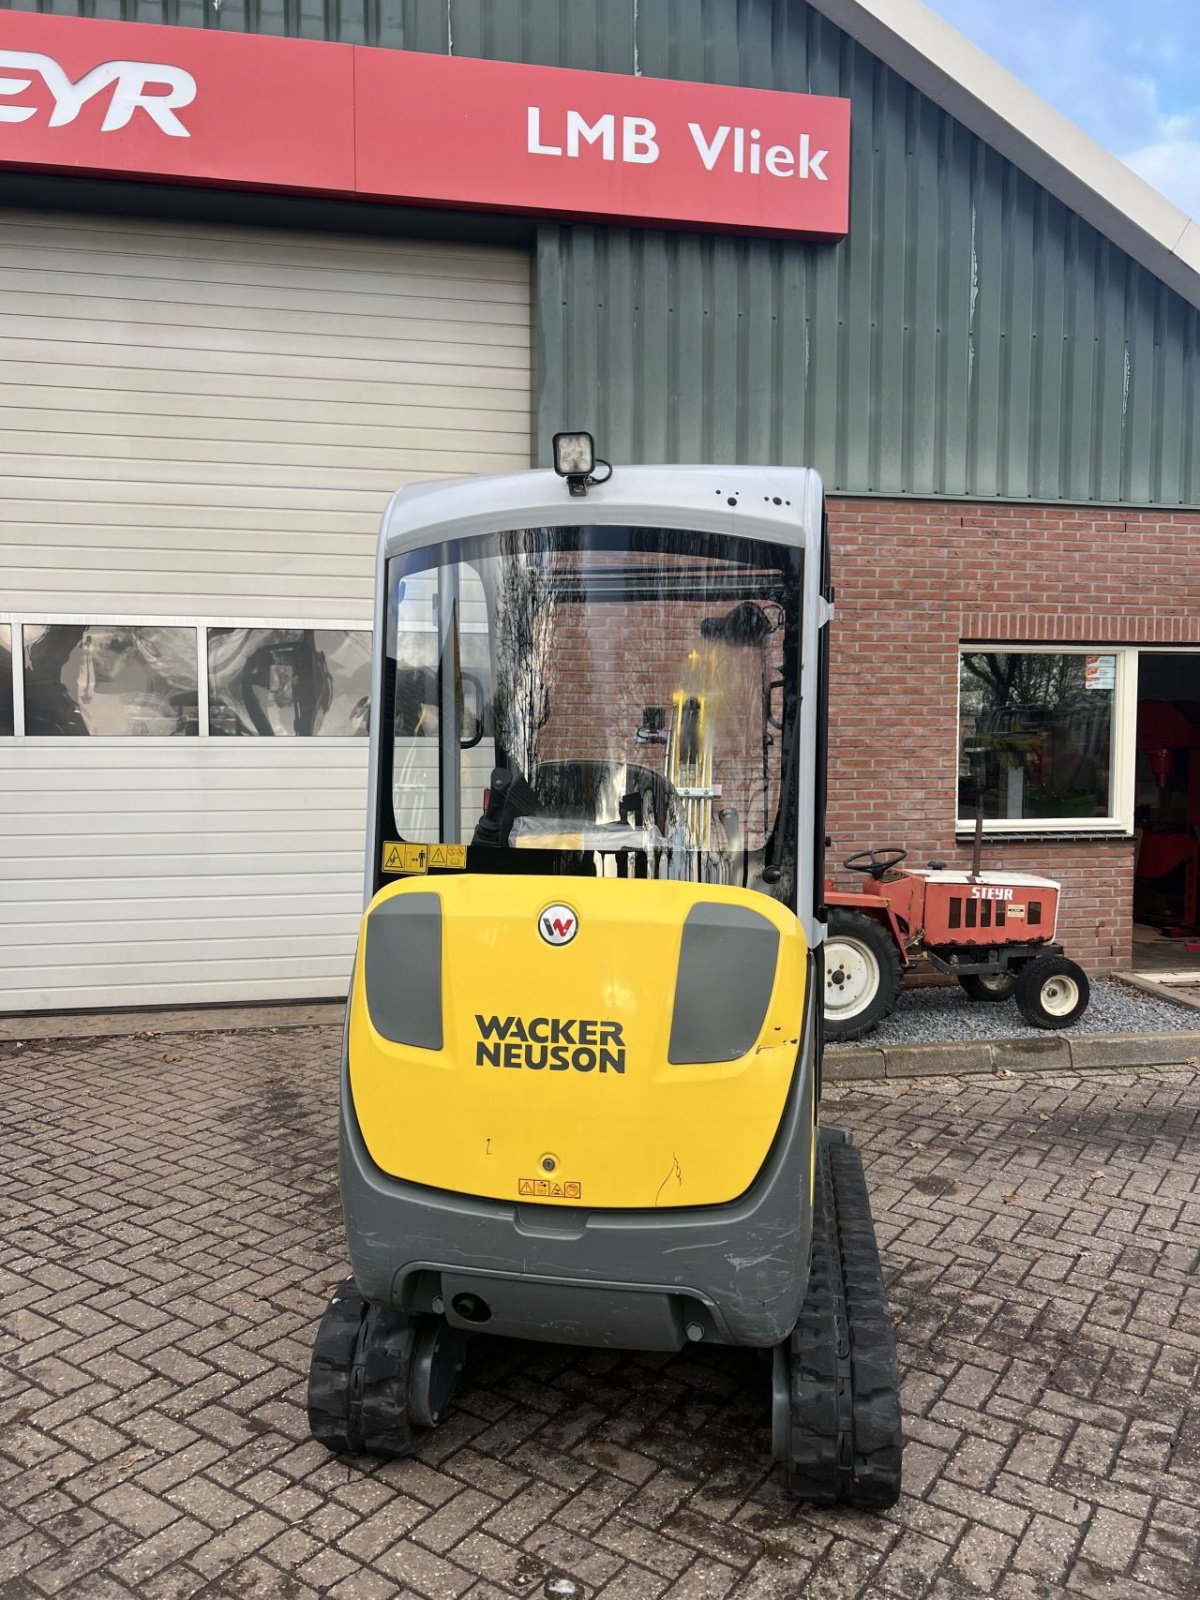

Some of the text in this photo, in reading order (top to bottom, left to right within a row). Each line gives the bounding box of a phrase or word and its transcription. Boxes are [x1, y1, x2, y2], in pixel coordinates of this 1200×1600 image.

[527, 106, 829, 181] LMB Vliek
[971, 886, 1013, 900] STEYR
[474, 1014, 626, 1047] WACKER
[475, 1041, 626, 1074] NEUSON
